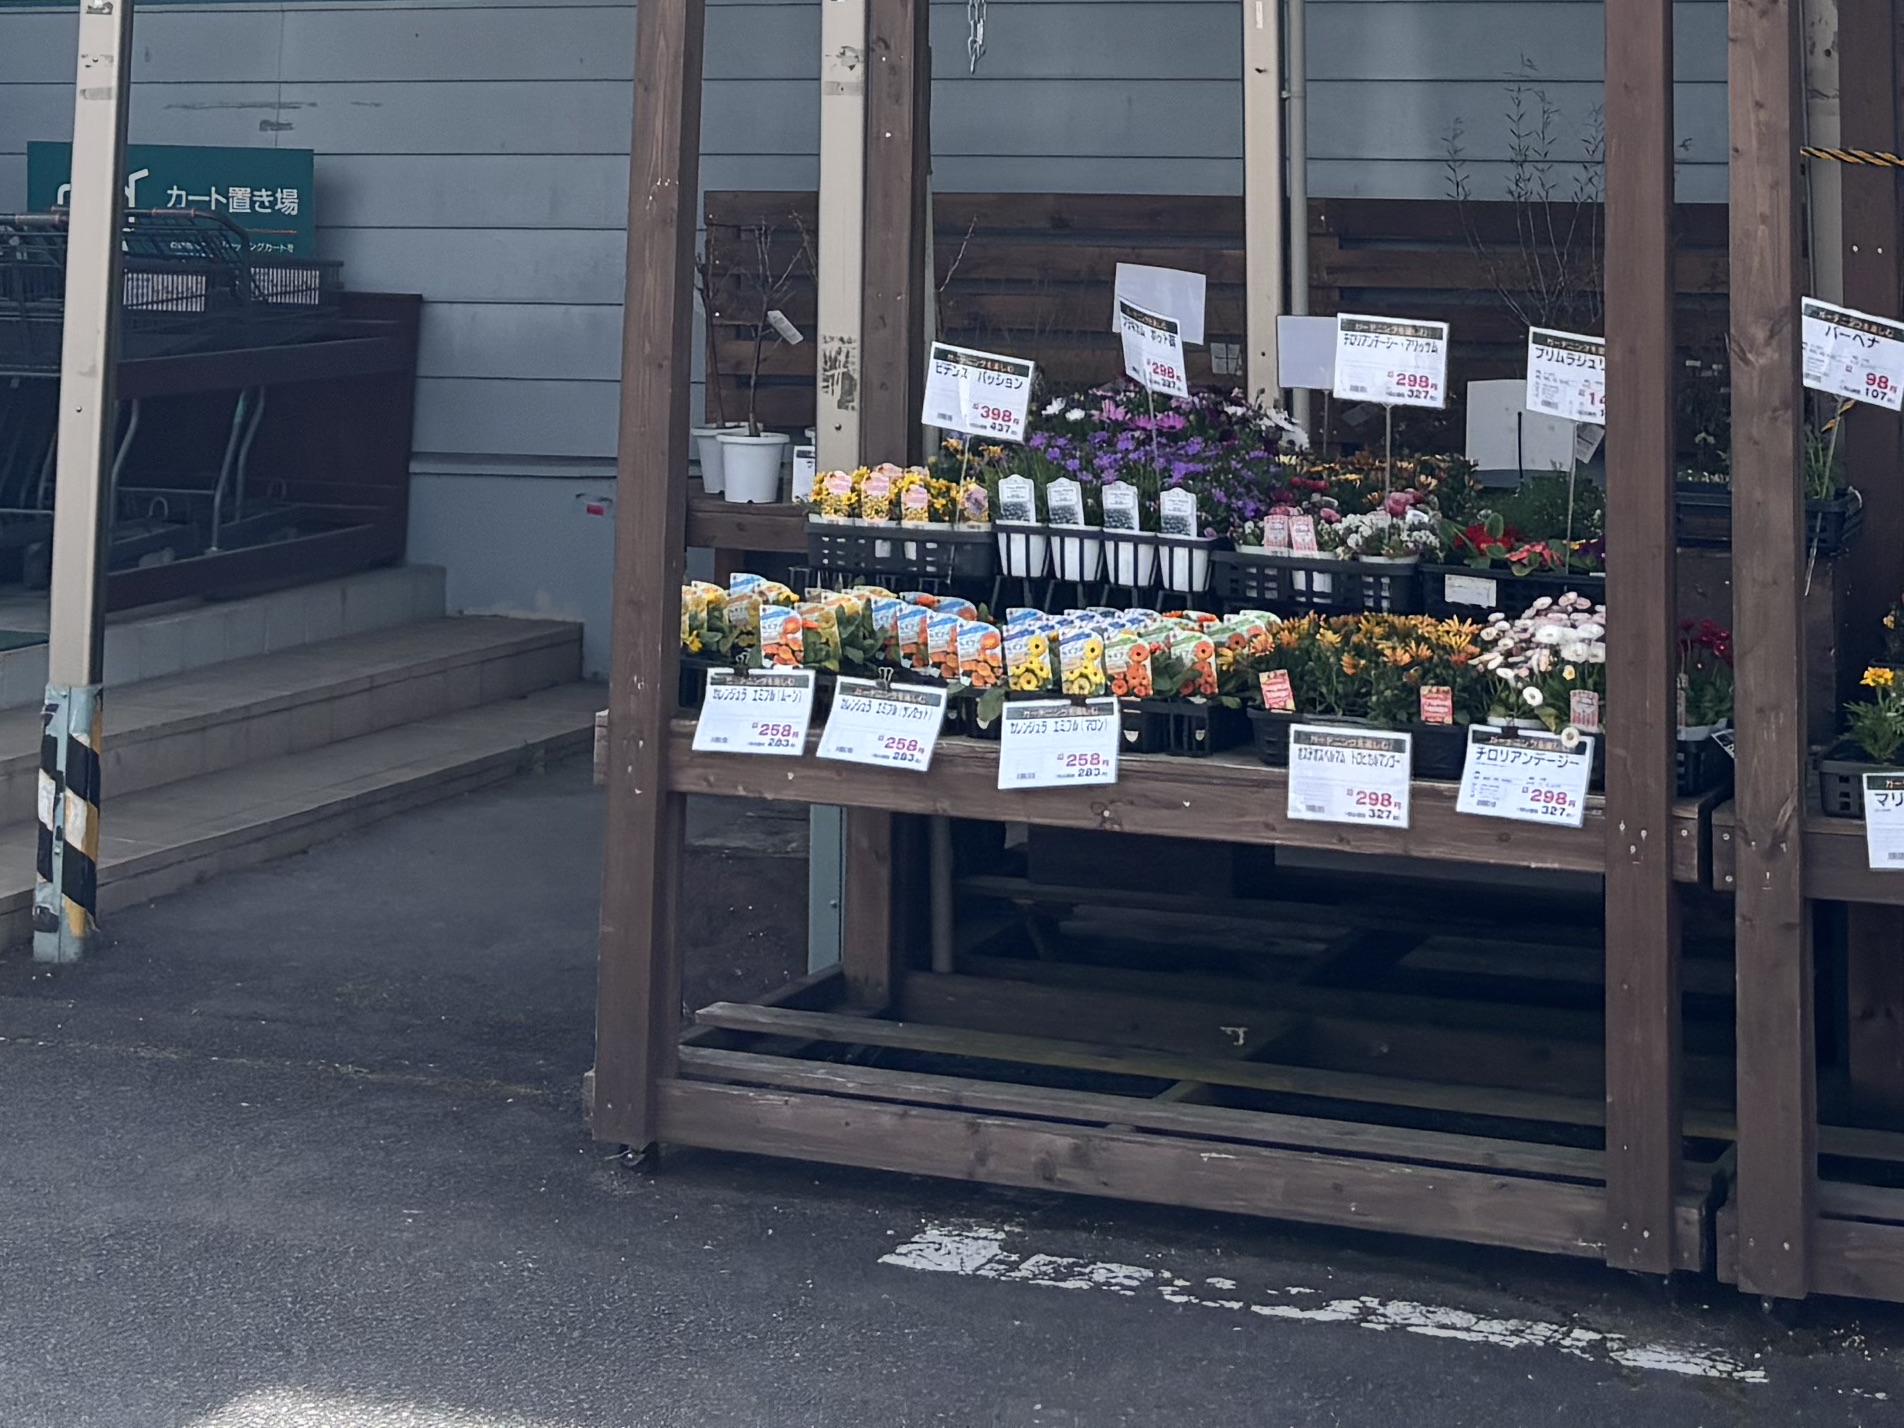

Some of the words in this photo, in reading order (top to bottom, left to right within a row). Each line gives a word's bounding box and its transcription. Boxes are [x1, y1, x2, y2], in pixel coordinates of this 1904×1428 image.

[166, 185, 299, 216] カート置き場
[1476, 747, 1580, 768] チロリアンデージー
